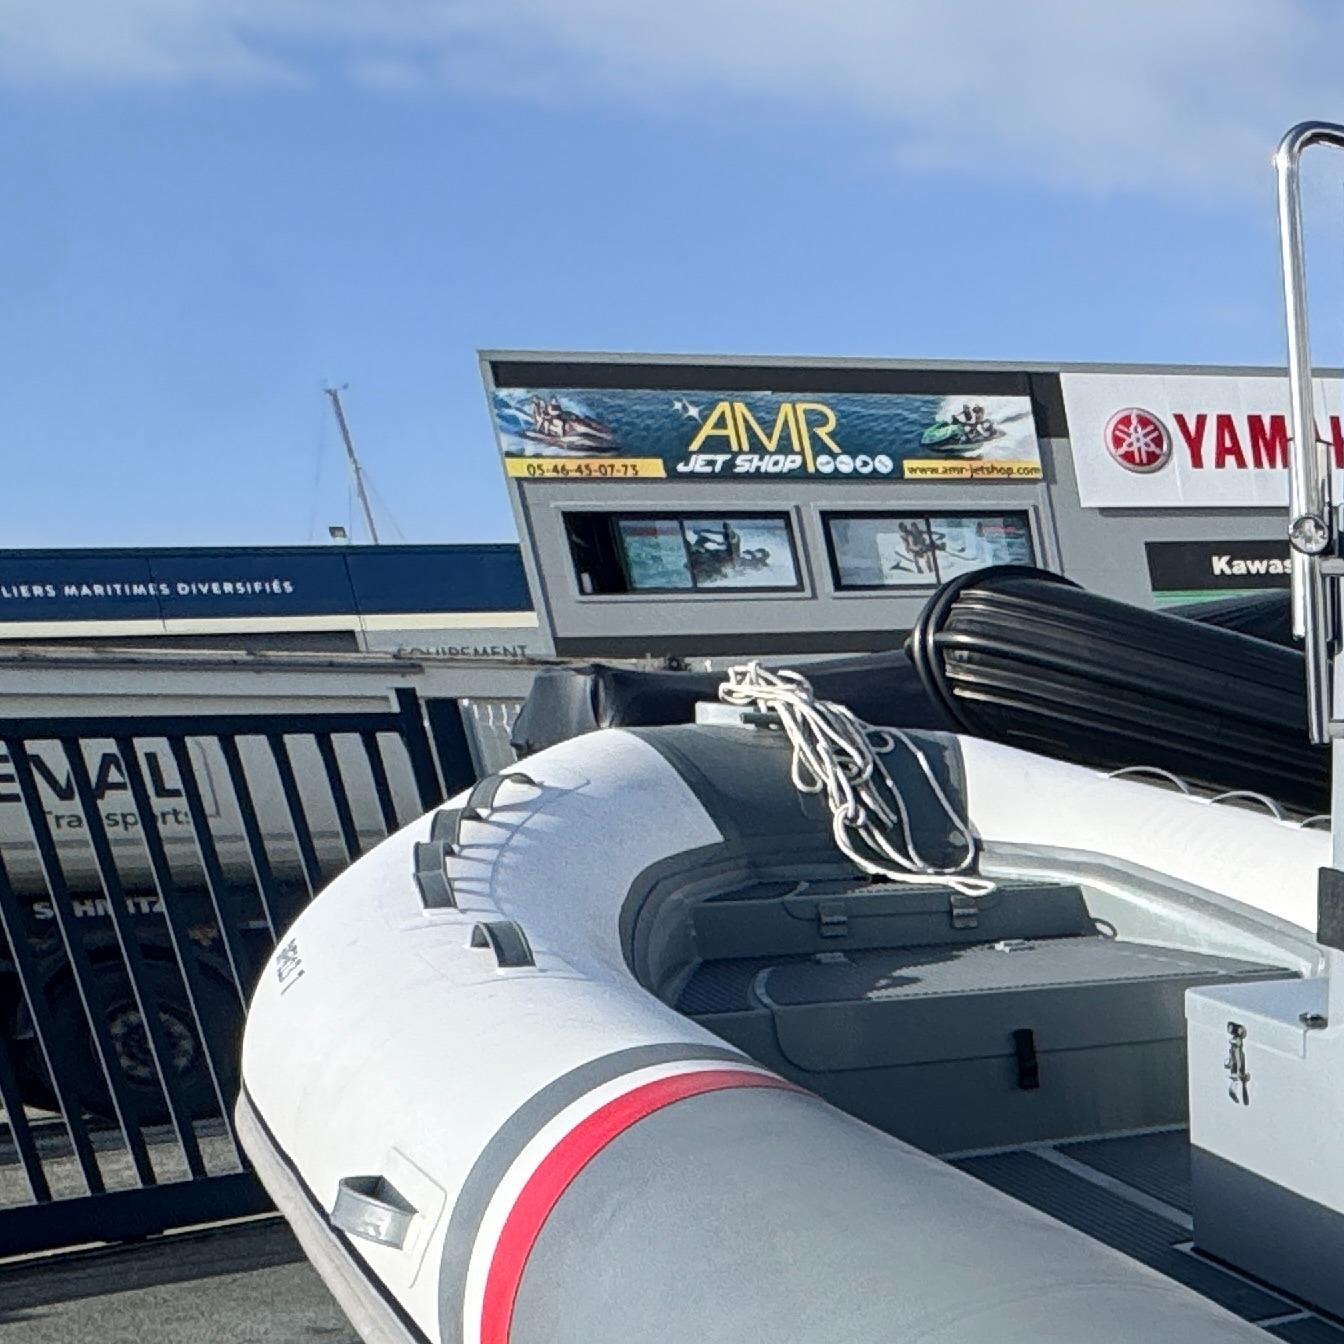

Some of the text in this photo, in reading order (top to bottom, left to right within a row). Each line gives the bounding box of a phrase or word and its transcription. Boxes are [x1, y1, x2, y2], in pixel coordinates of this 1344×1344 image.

[689, 401, 841, 473] AMR
[677, 453, 802, 475] JET SHOP
[907, 464, 1041, 479] www.amr-jetshop.com
[1, 578, 294, 598] LIERS MARITIMES DIVERSIFIÉS
